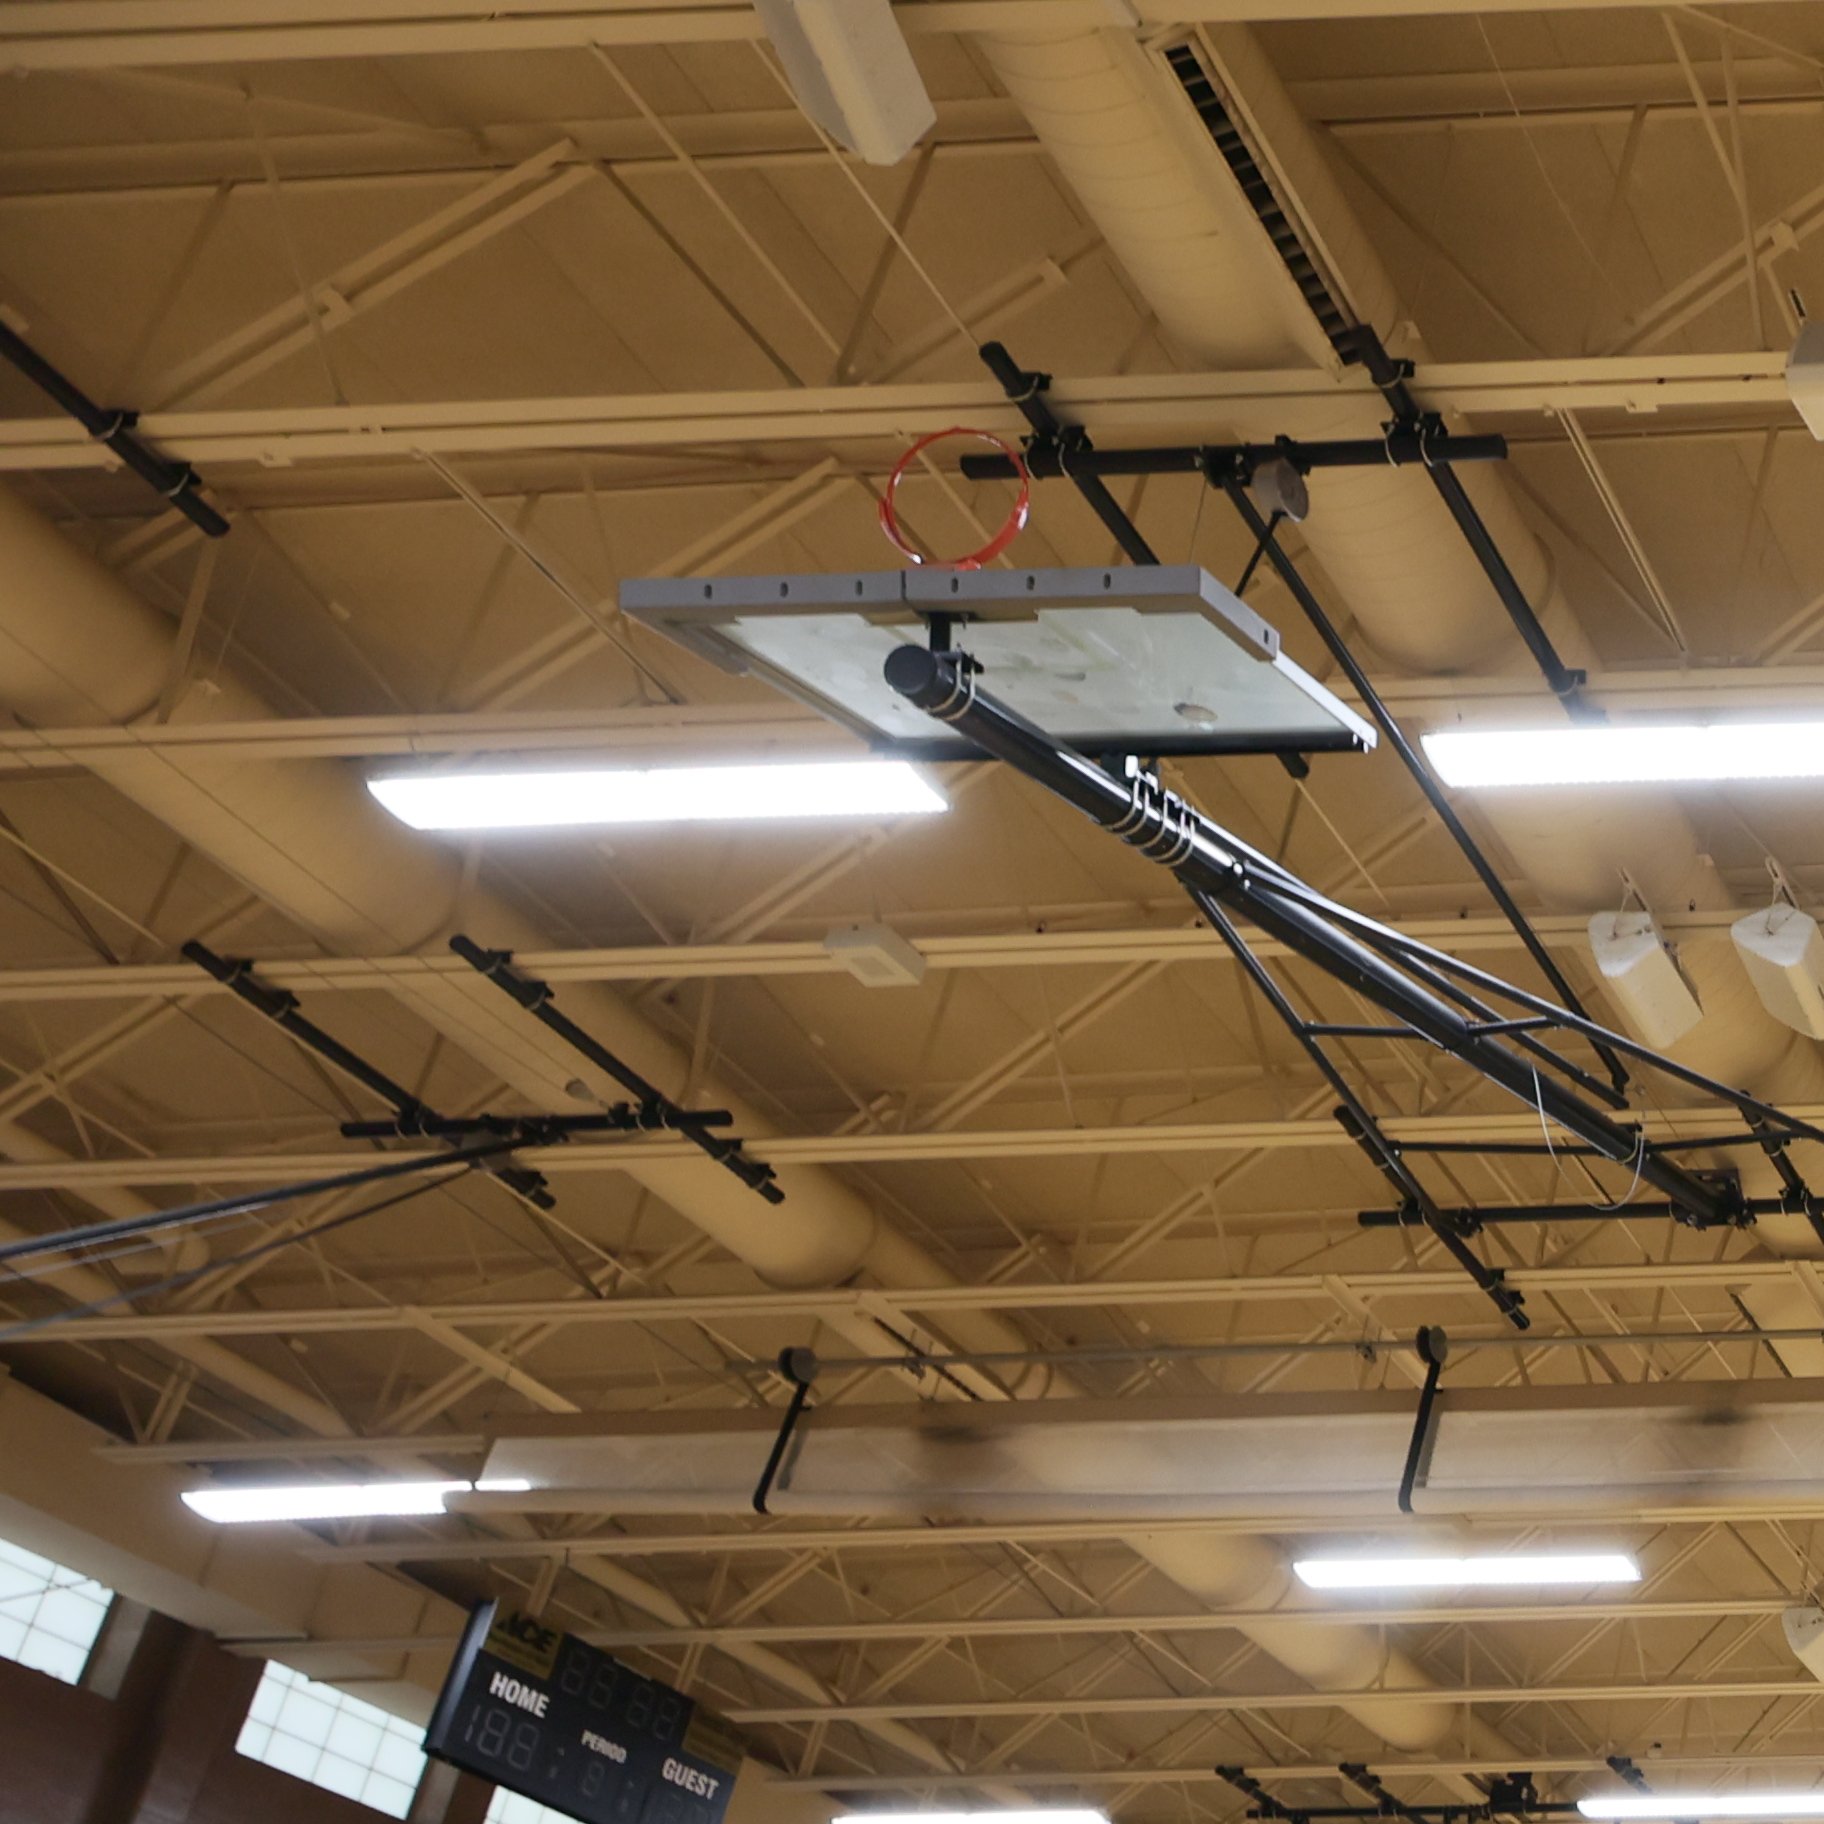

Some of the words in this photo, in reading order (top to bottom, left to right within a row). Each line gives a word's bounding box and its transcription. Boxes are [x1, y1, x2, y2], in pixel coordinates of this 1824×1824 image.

[497, 1612, 557, 1649] ACE
[489, 1671, 550, 1718] HOME
[581, 1729, 627, 1764] PERIOD
[662, 1757, 720, 1800] GUEST
